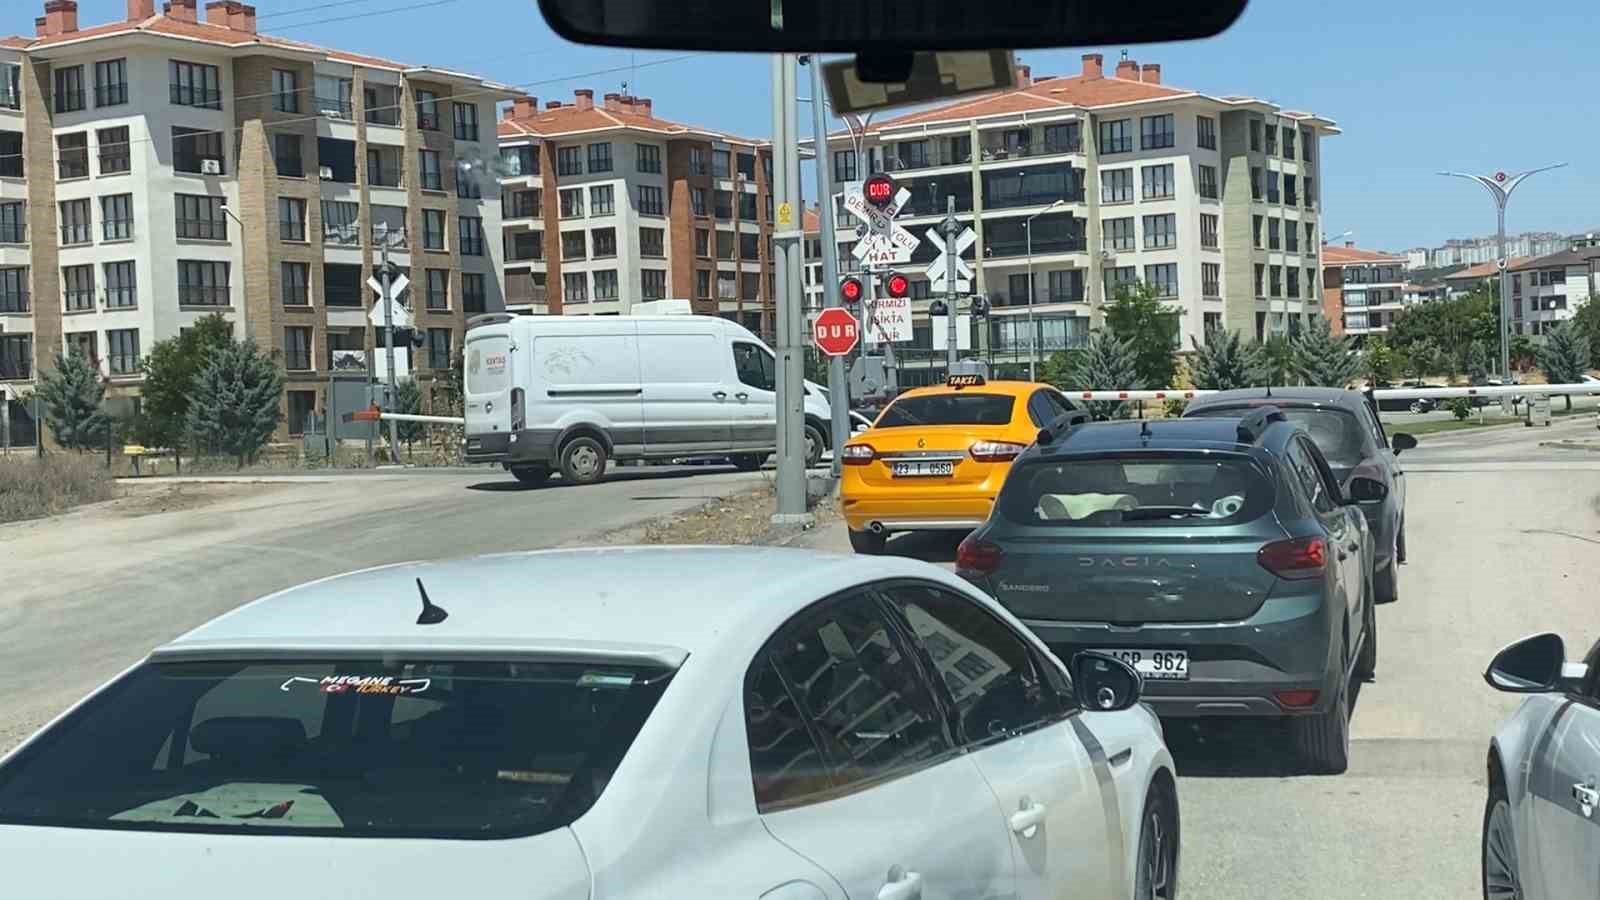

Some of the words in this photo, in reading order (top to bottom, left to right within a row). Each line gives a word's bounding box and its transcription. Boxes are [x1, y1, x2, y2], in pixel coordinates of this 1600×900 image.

[869, 184, 890, 196] DUR
[869, 251, 897, 261] HAT
[817, 324, 854, 338] DUR
[1079, 557, 1169, 566] DACIA
[1002, 584, 1049, 592] SANDERO
[1153, 652, 1185, 671] 962
[320, 675, 393, 686] MEGANE
